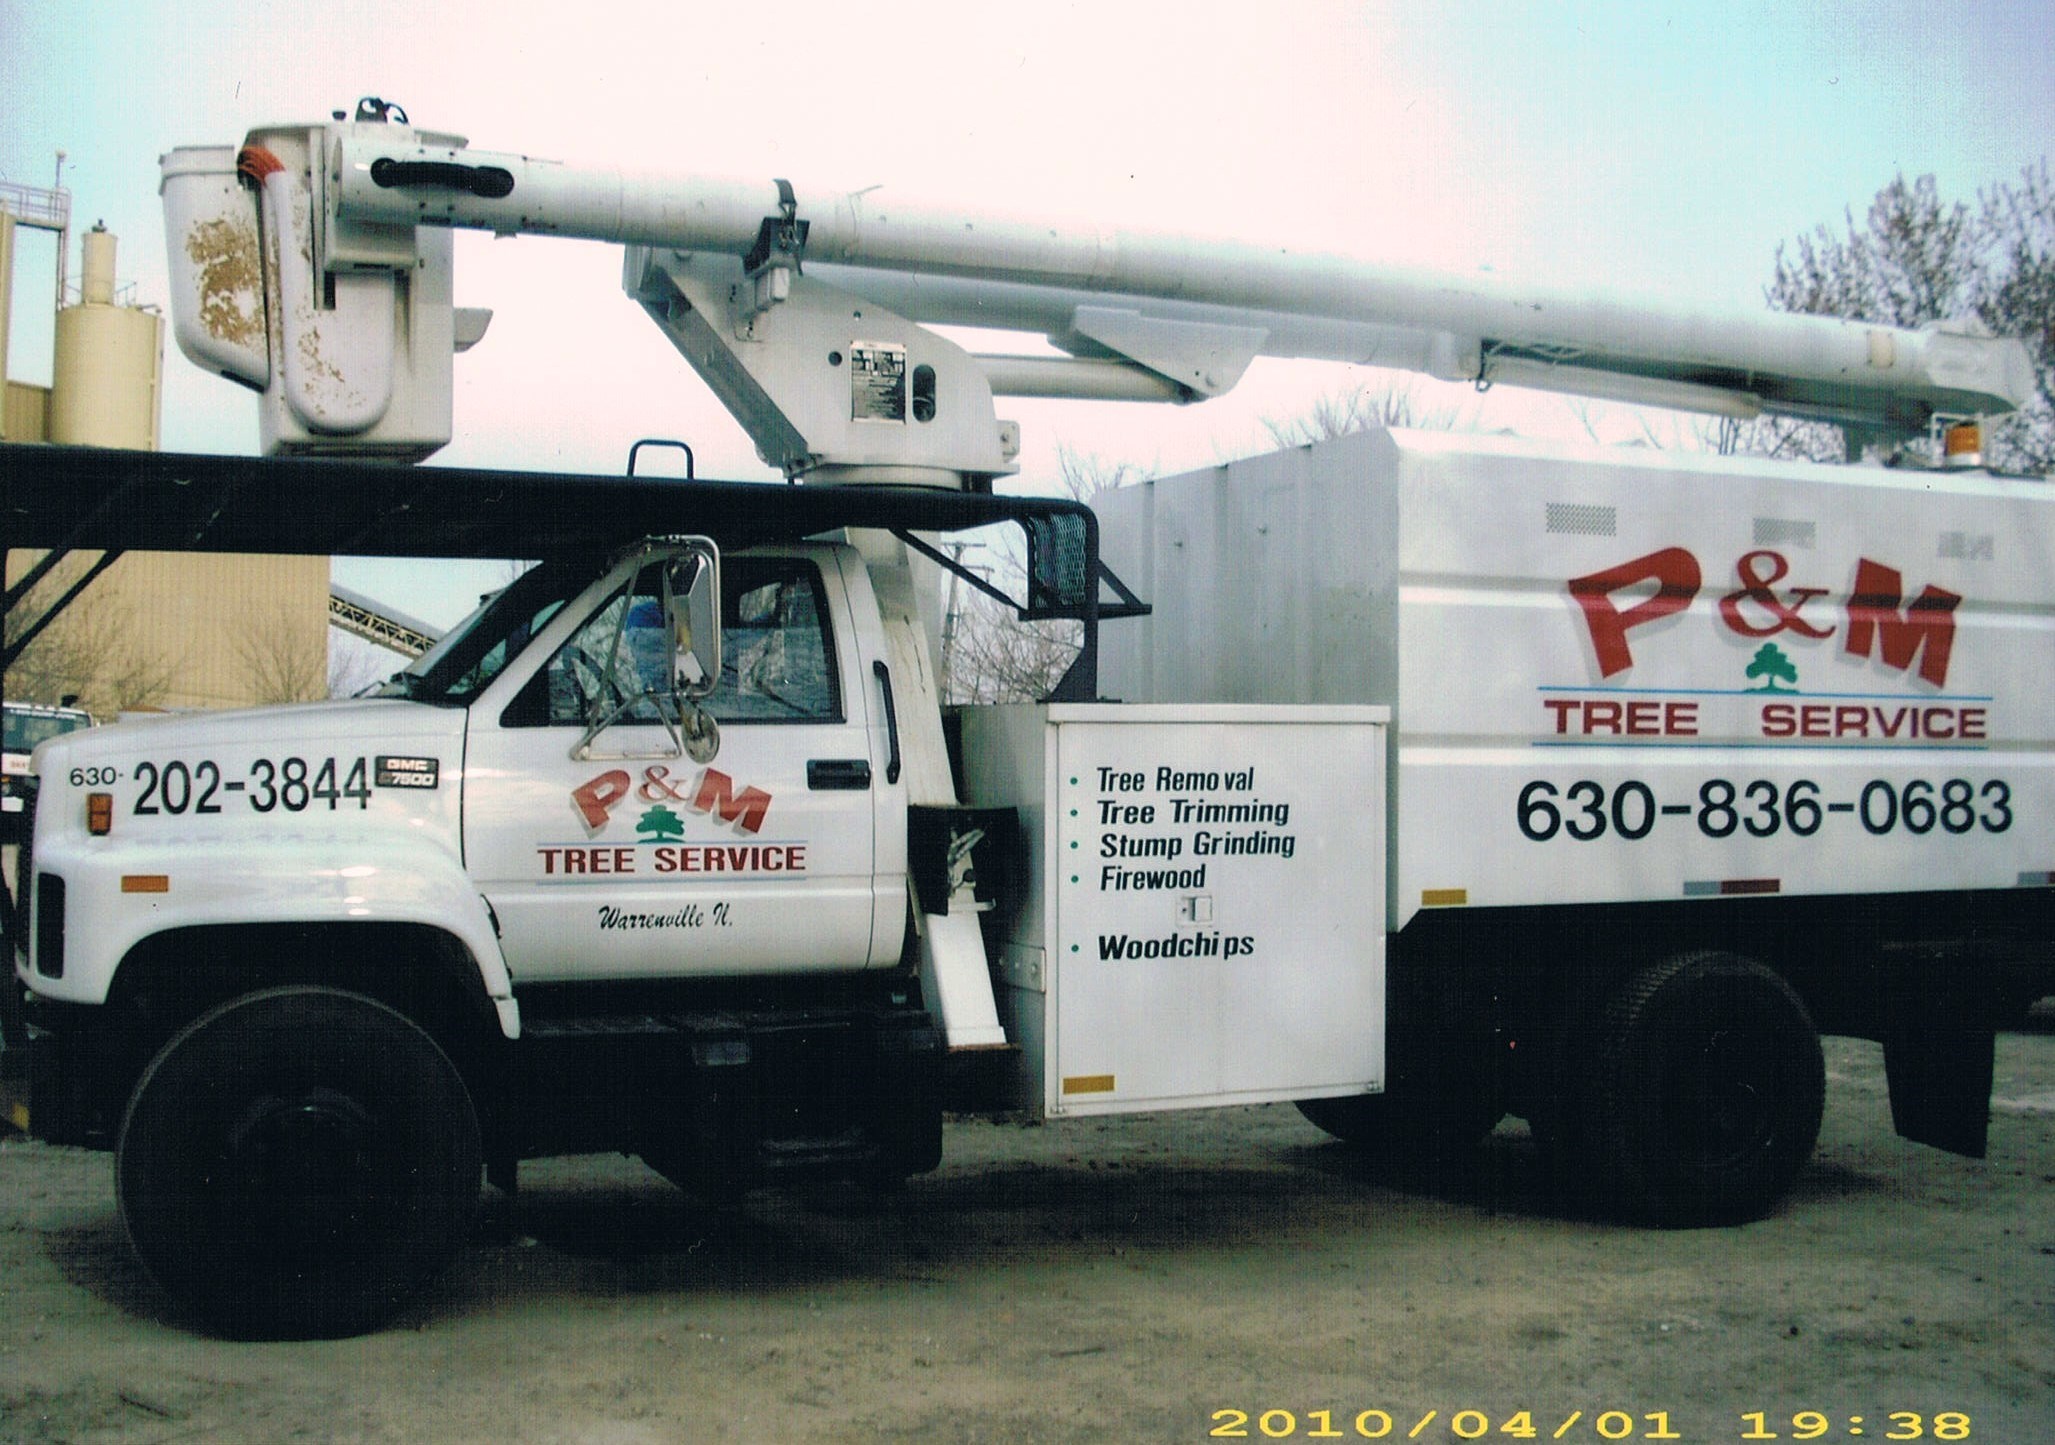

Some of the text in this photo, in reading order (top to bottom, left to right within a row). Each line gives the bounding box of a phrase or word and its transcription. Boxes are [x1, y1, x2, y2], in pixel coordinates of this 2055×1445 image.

[1544, 700, 1988, 739] TREE SERVICE
[386, 758, 428, 771] GMC
[133, 757, 373, 816] 202-3844
[1097, 766, 1255, 792] Tree Removal
[1097, 799, 1290, 827] Tree Trimming
[1516, 778, 2014, 842] 630-836-0683
[537, 846, 807, 874] TREE SERVICE
[1100, 831, 1296, 861] Stump Grinding
[1101, 864, 1207, 892] Firewood
[598, 903, 705, 931] Warrenville
[1098, 931, 1255, 961] Woodchips
